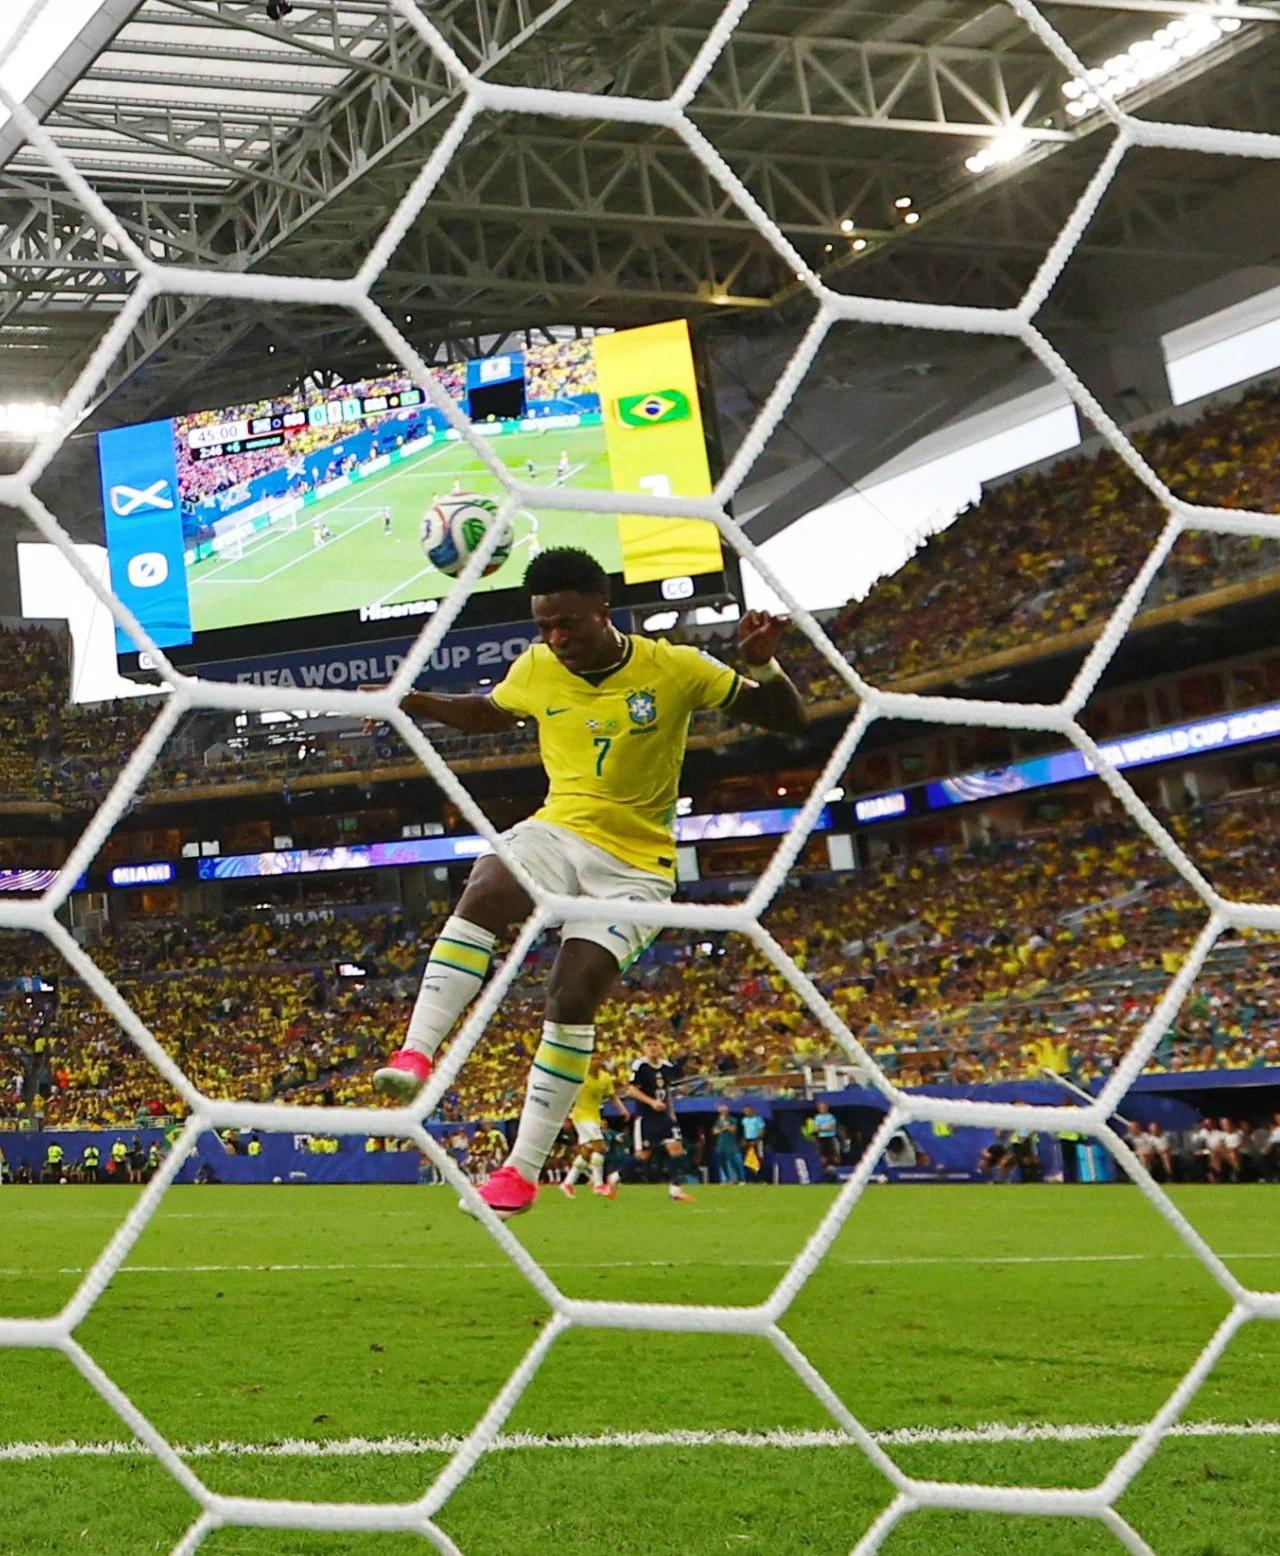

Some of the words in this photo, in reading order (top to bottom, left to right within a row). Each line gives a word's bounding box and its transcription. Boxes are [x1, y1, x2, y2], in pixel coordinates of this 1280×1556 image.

[667, 581, 689, 595] CC
[359, 600, 439, 622] Hisense
[236, 664, 298, 688] FIFA
[300, 653, 401, 687] WORLD
[476, 634, 542, 667] 20
[593, 737, 612, 777] 7
[111, 864, 171, 885] MIAMI
